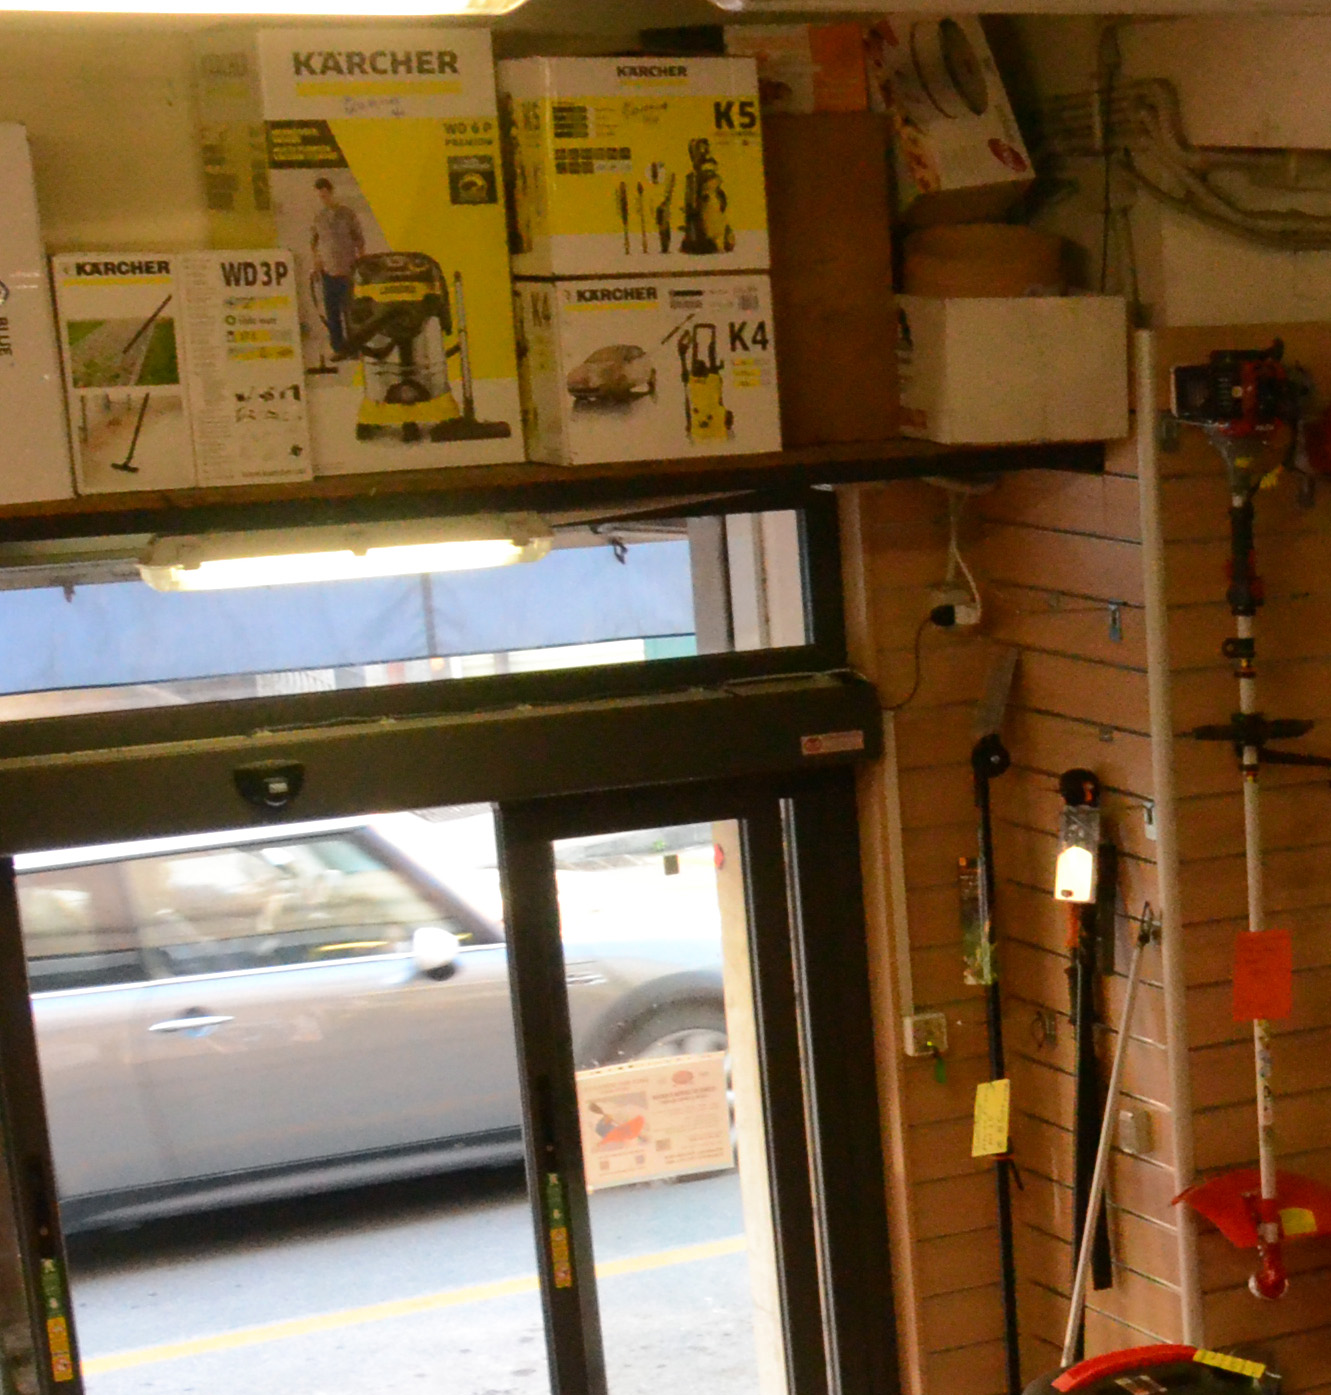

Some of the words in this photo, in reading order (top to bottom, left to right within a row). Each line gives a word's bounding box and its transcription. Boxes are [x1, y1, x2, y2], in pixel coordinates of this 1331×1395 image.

[293, 51, 459, 75] KÄRCHER
[617, 66, 687, 77] KÄRCHER
[728, 321, 768, 350] K4
